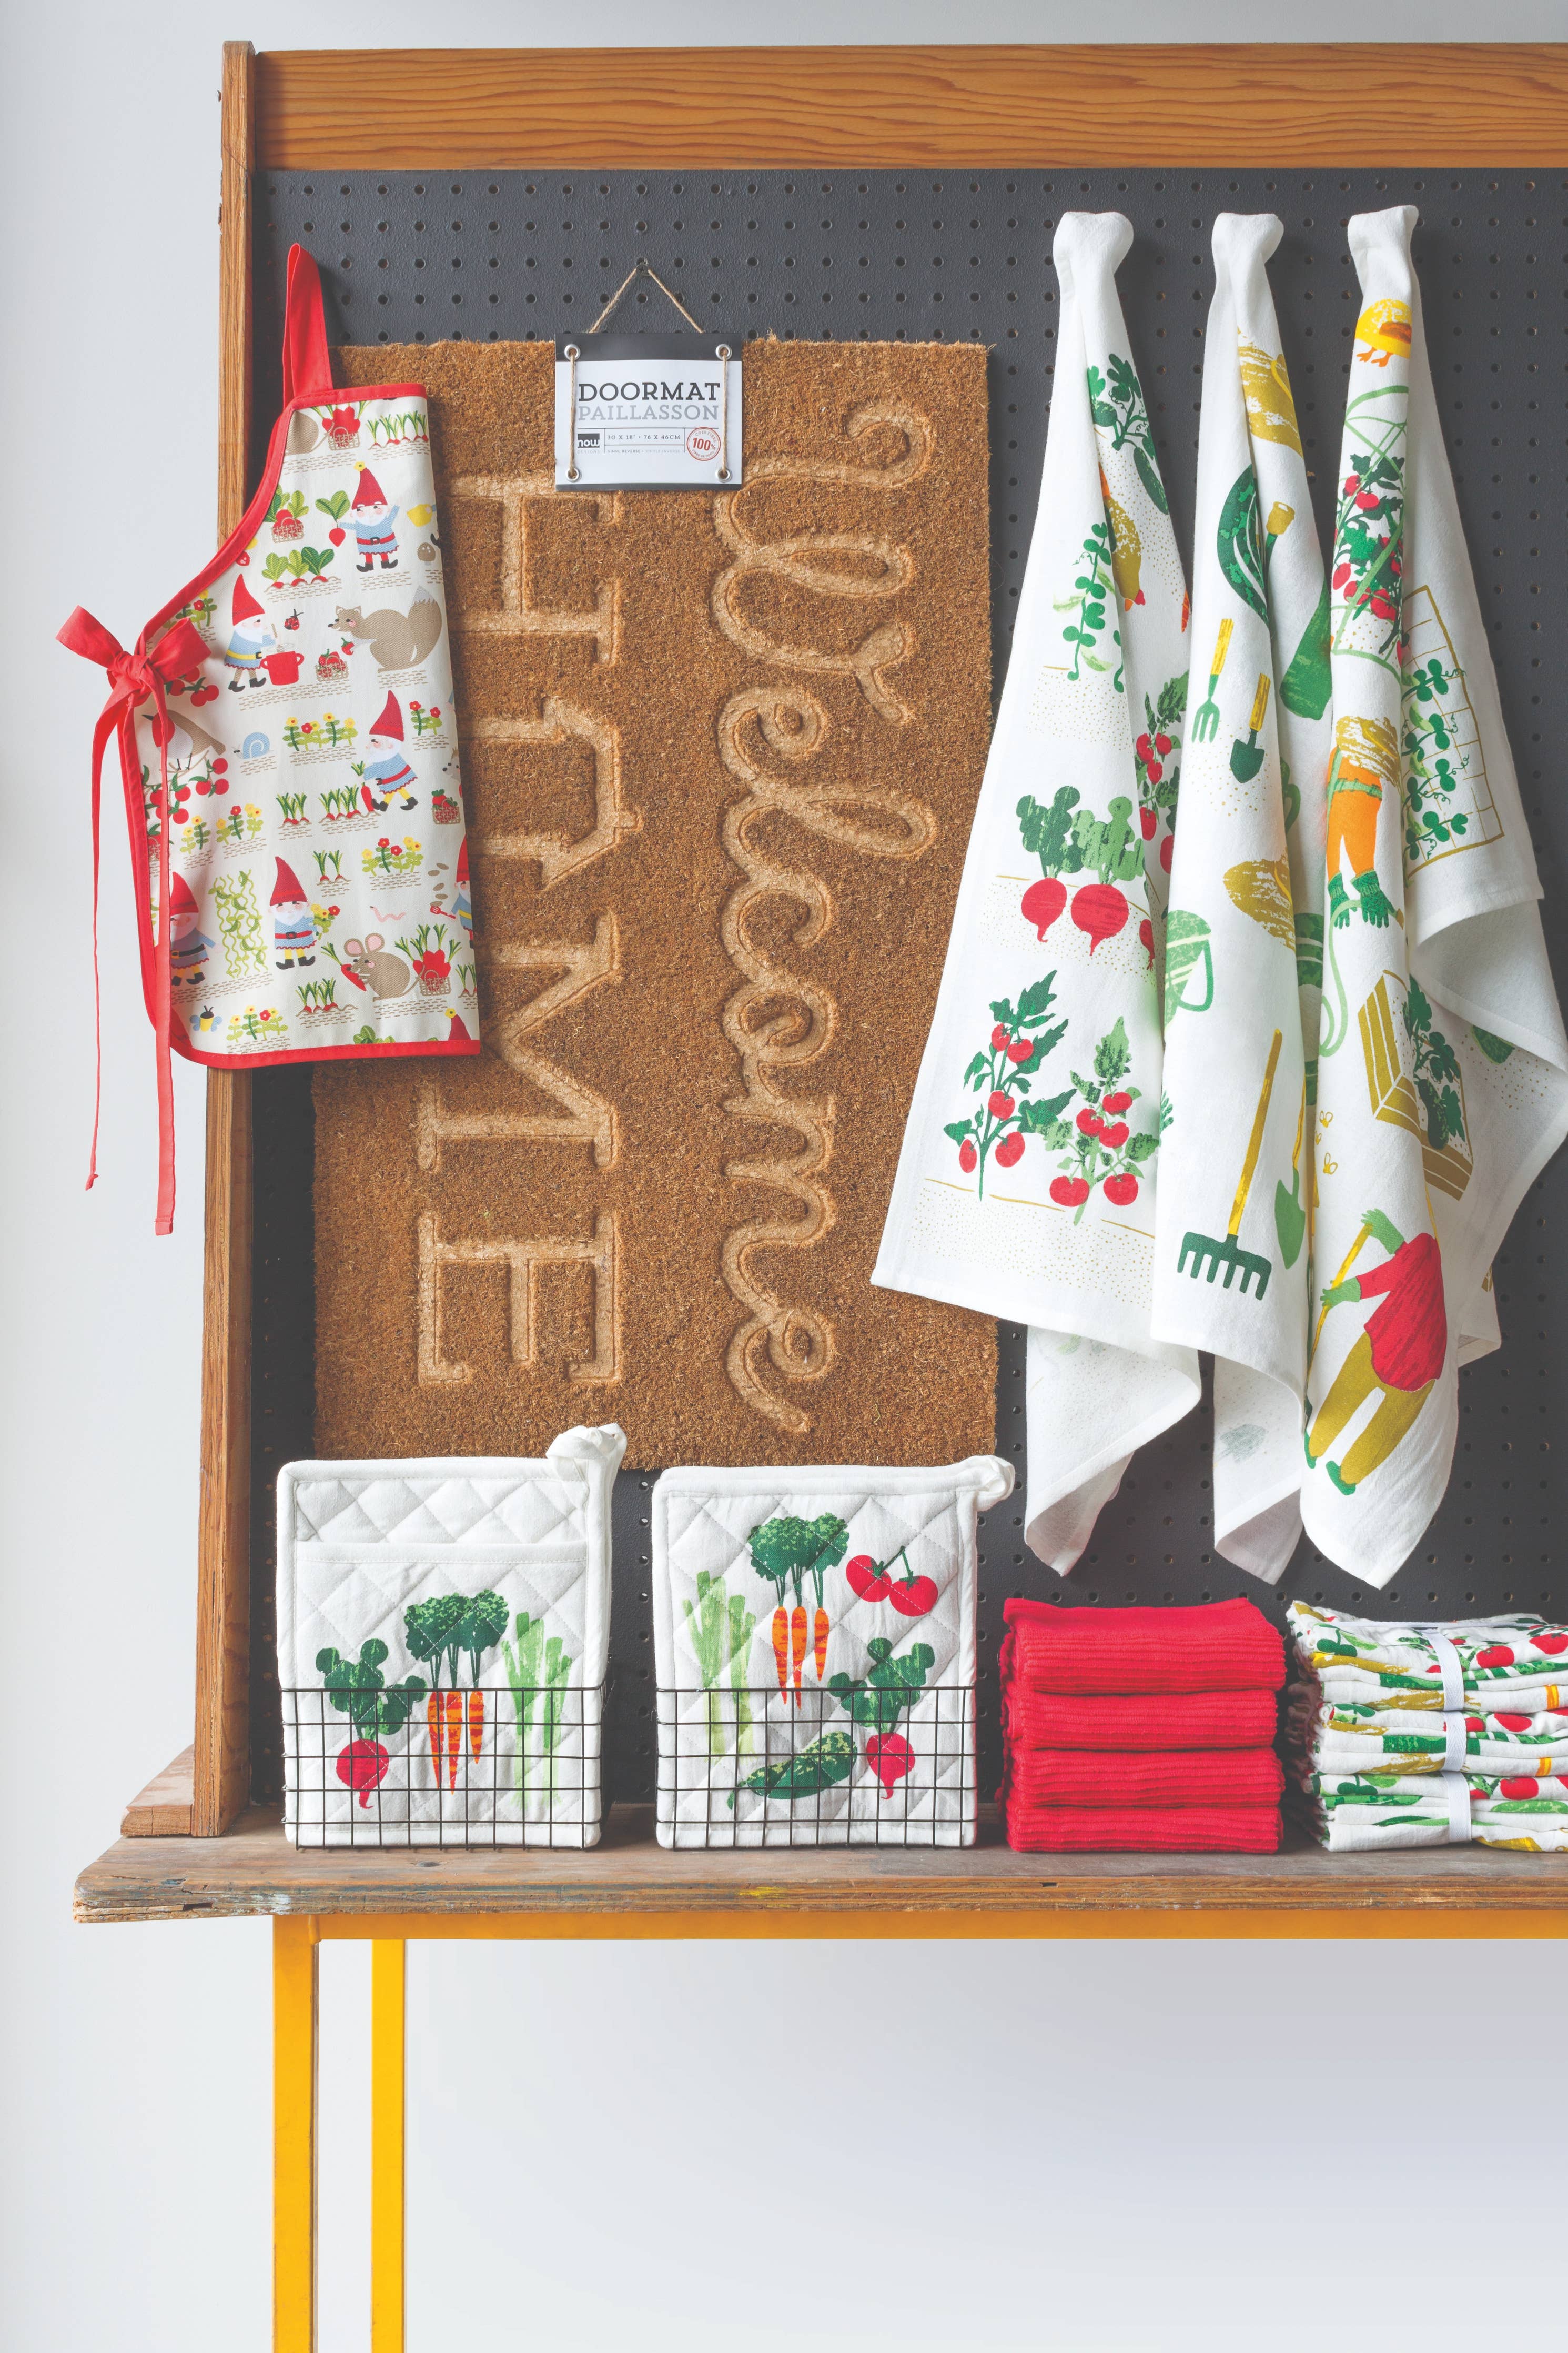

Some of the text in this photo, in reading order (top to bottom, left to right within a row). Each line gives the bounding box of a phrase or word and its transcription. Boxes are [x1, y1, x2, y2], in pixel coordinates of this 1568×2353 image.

[579, 382, 720, 401] DOORMAT
[578, 404, 719, 421] PAILLASSON
[578, 439, 600, 447] now
[693, 438, 715, 450] 100%
[711, 401, 939, 1434] Welcome
